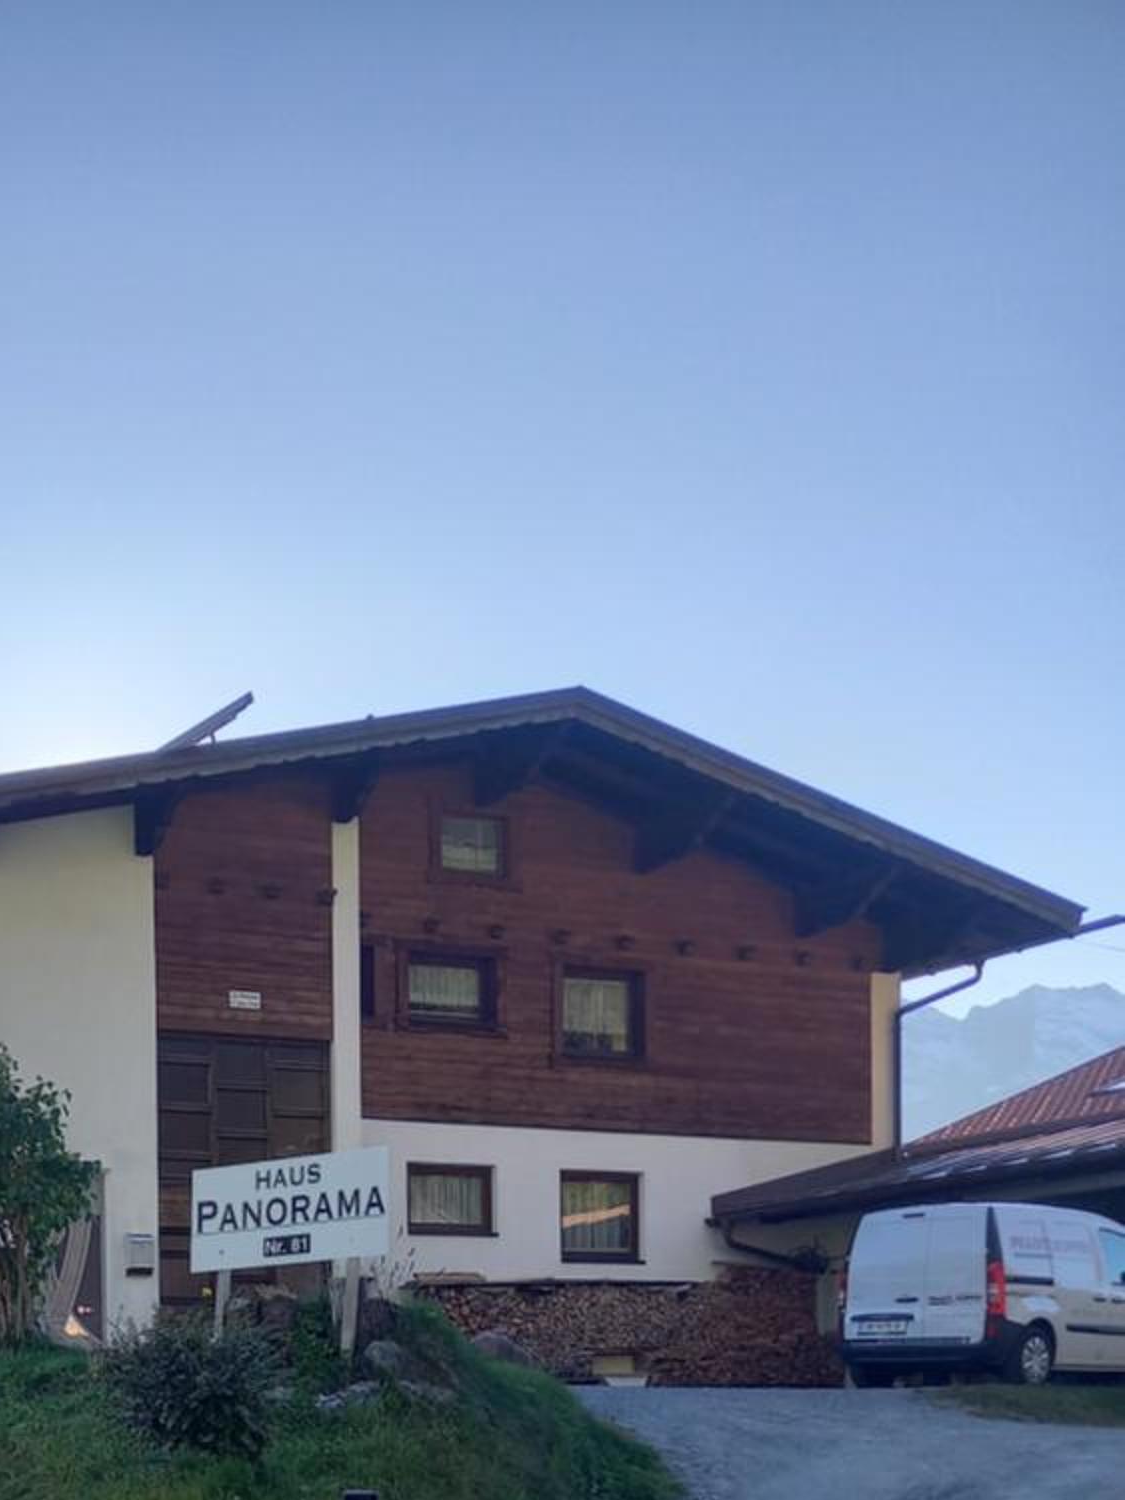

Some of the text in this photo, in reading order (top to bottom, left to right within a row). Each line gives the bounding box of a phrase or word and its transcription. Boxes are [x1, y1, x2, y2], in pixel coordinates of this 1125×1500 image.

[255, 1163, 321, 1190] HAUS
[197, 1186, 385, 1233] PANORAMA
[265, 1239, 287, 1254] Nr.
